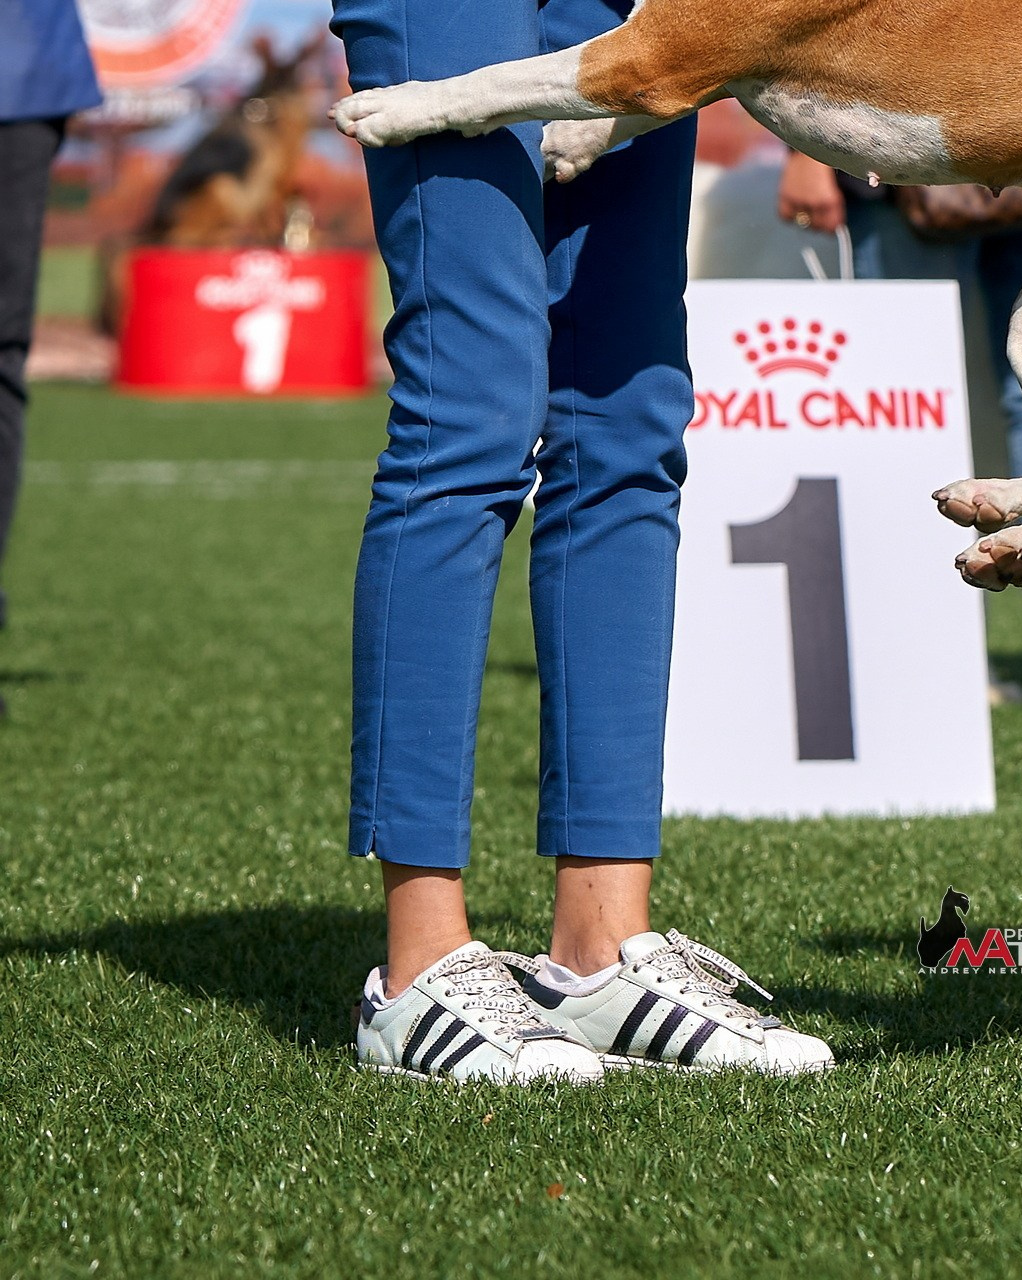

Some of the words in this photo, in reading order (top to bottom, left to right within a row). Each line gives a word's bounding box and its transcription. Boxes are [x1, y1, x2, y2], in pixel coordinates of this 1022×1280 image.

[688, 391, 787, 428] YAL
[799, 390, 945, 429] CANIN
[727, 477, 857, 761] 1
